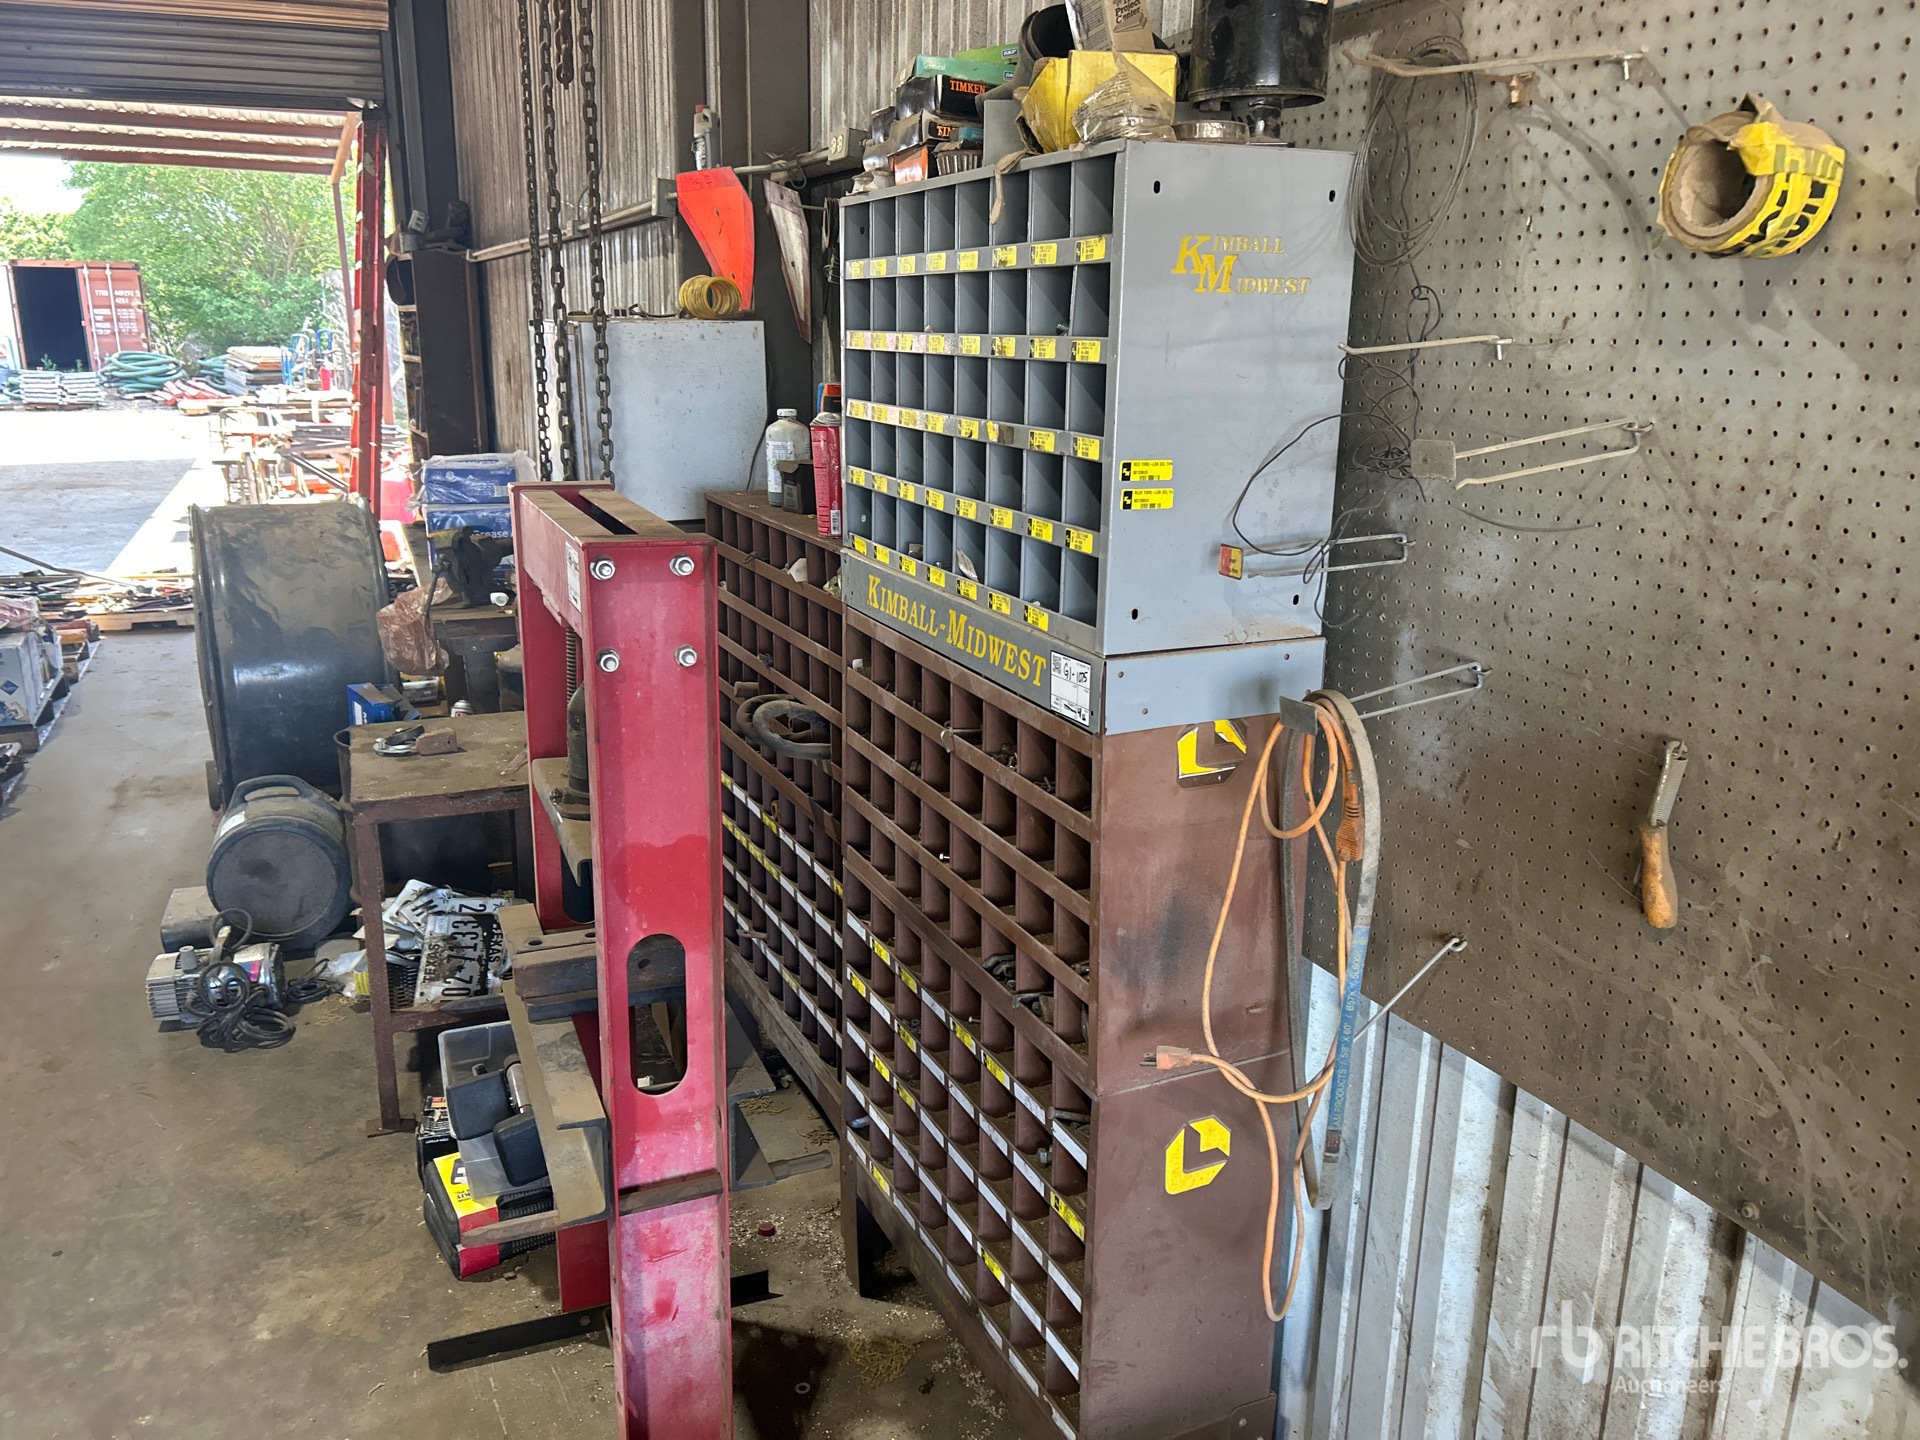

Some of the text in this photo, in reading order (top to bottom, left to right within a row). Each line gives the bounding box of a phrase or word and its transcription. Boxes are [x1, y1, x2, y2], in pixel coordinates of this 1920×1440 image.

[1115, 0, 1141, 17] Project
[1116, 7, 1141, 24] Center
[949, 79, 986, 95] TIMKEN
[1171, 234, 1286, 274] KIMBALL
[1194, 254, 1311, 294] MIDWEST
[866, 574, 1048, 687] KIMBALL-MIDWEST
[422, 943, 440, 983] TEXAS
[1334, 1068, 1347, 1114] PRODUCTS
